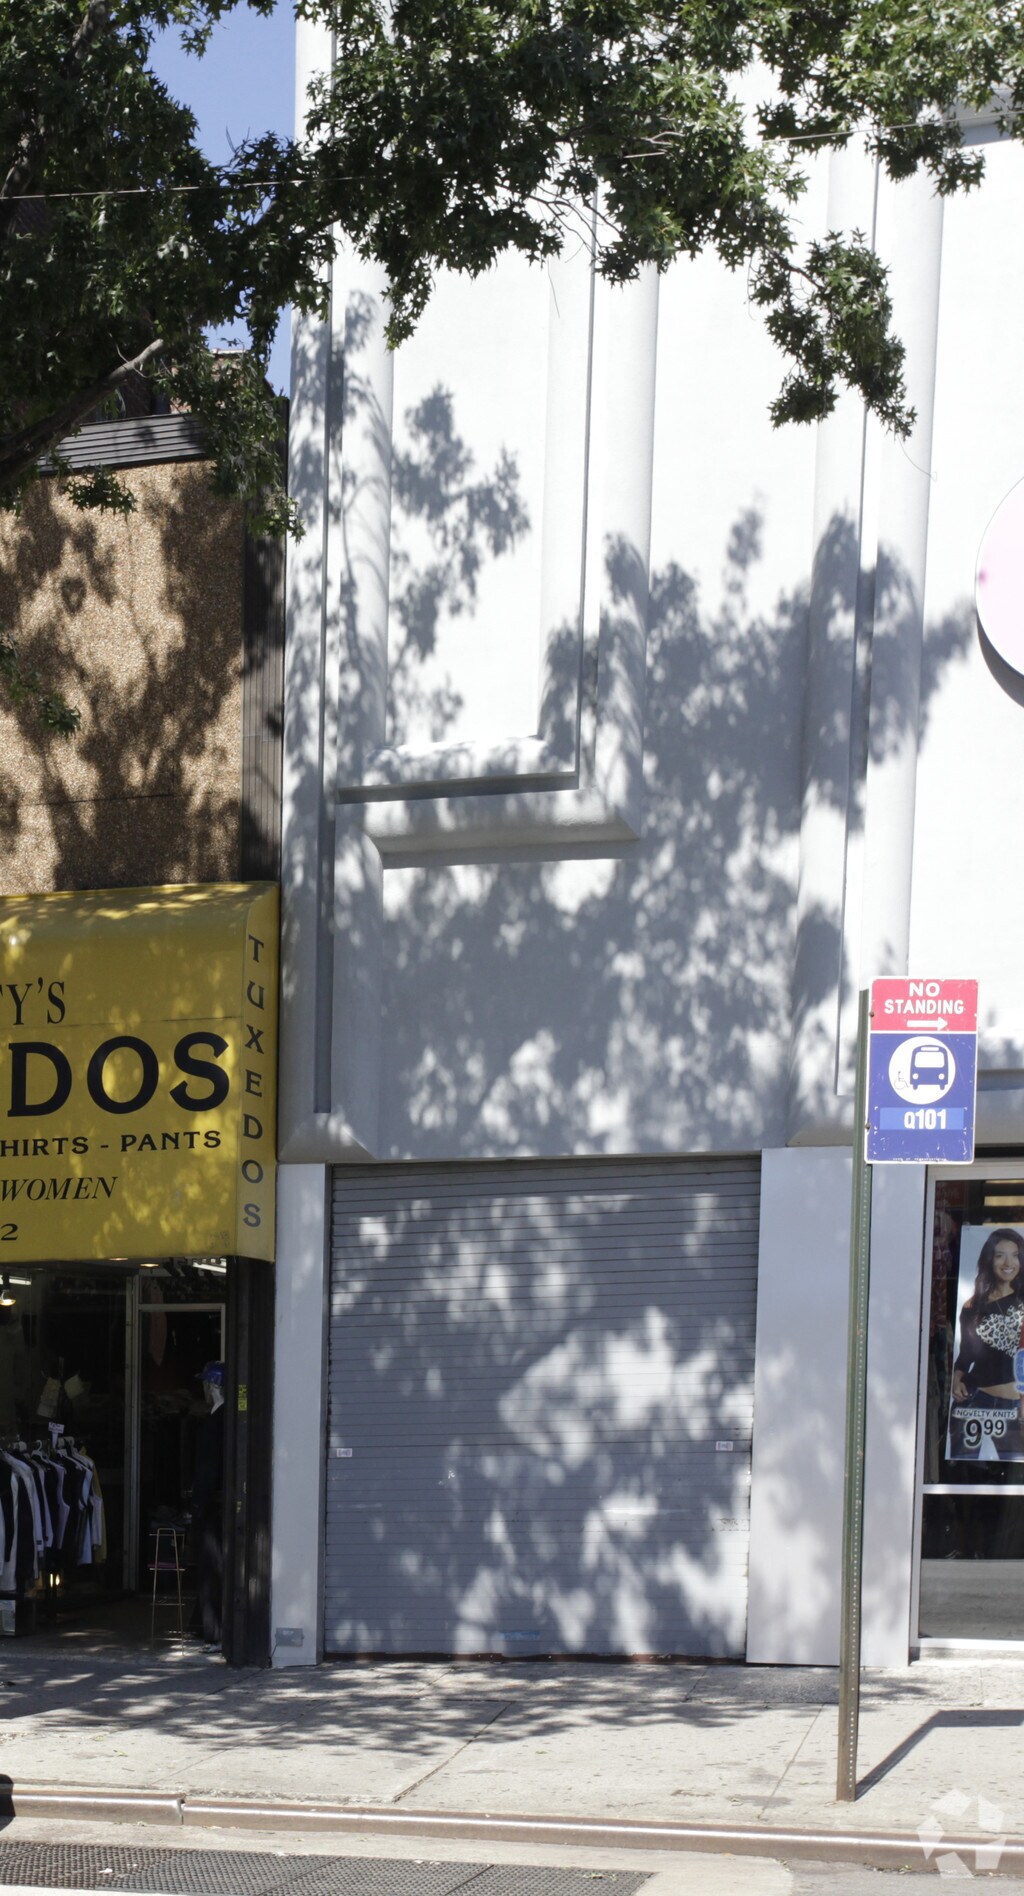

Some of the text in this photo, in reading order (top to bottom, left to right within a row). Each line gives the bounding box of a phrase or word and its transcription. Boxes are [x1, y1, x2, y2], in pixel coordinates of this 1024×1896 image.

[908, 982, 941, 997] NO
[884, 999, 965, 1015] STANDING
[241, 935, 266, 1228] TUXEDOS
[903, 1108, 947, 1130] Q101
[120, 1131, 222, 1153] PANTS
[0, 1177, 119, 1201] WOMEN
[957, 1409, 991, 1417] NOVELTY
